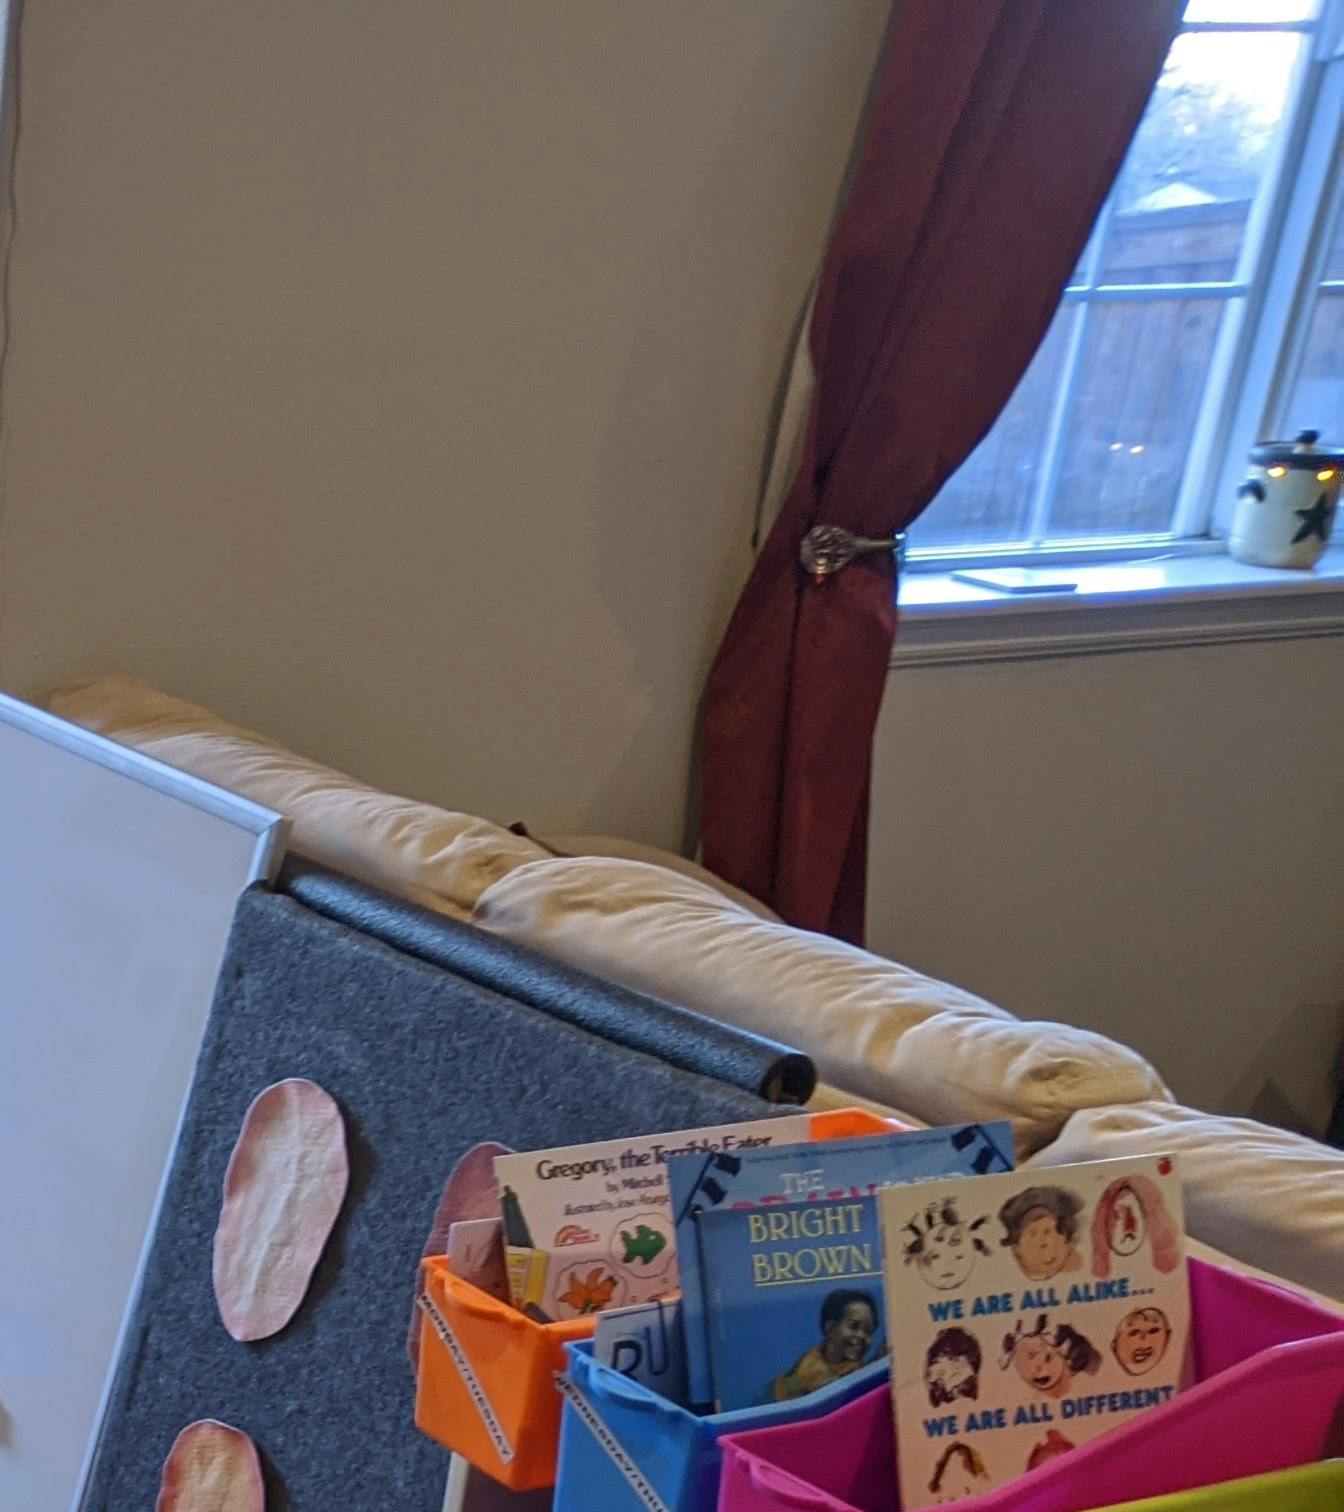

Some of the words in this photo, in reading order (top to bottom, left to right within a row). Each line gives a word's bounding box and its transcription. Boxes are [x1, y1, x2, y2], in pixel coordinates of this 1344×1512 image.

[536, 1156, 618, 1182] Gregory,
[620, 1148, 652, 1169] the
[781, 1169, 825, 1195] THE
[748, 1204, 864, 1243] BRIGHT
[752, 1245, 874, 1283] BROWN
[928, 1300, 964, 1322] WE
[970, 1292, 1013, 1317] ARE
[1019, 1288, 1061, 1311] ALL
[1066, 1276, 1155, 1304] ALIKE...
[923, 1416, 960, 1439] WE
[965, 1409, 1008, 1432] ARE
[1013, 1402, 1054, 1424] ALL
[1061, 1385, 1175, 1419] DIFFERENT
